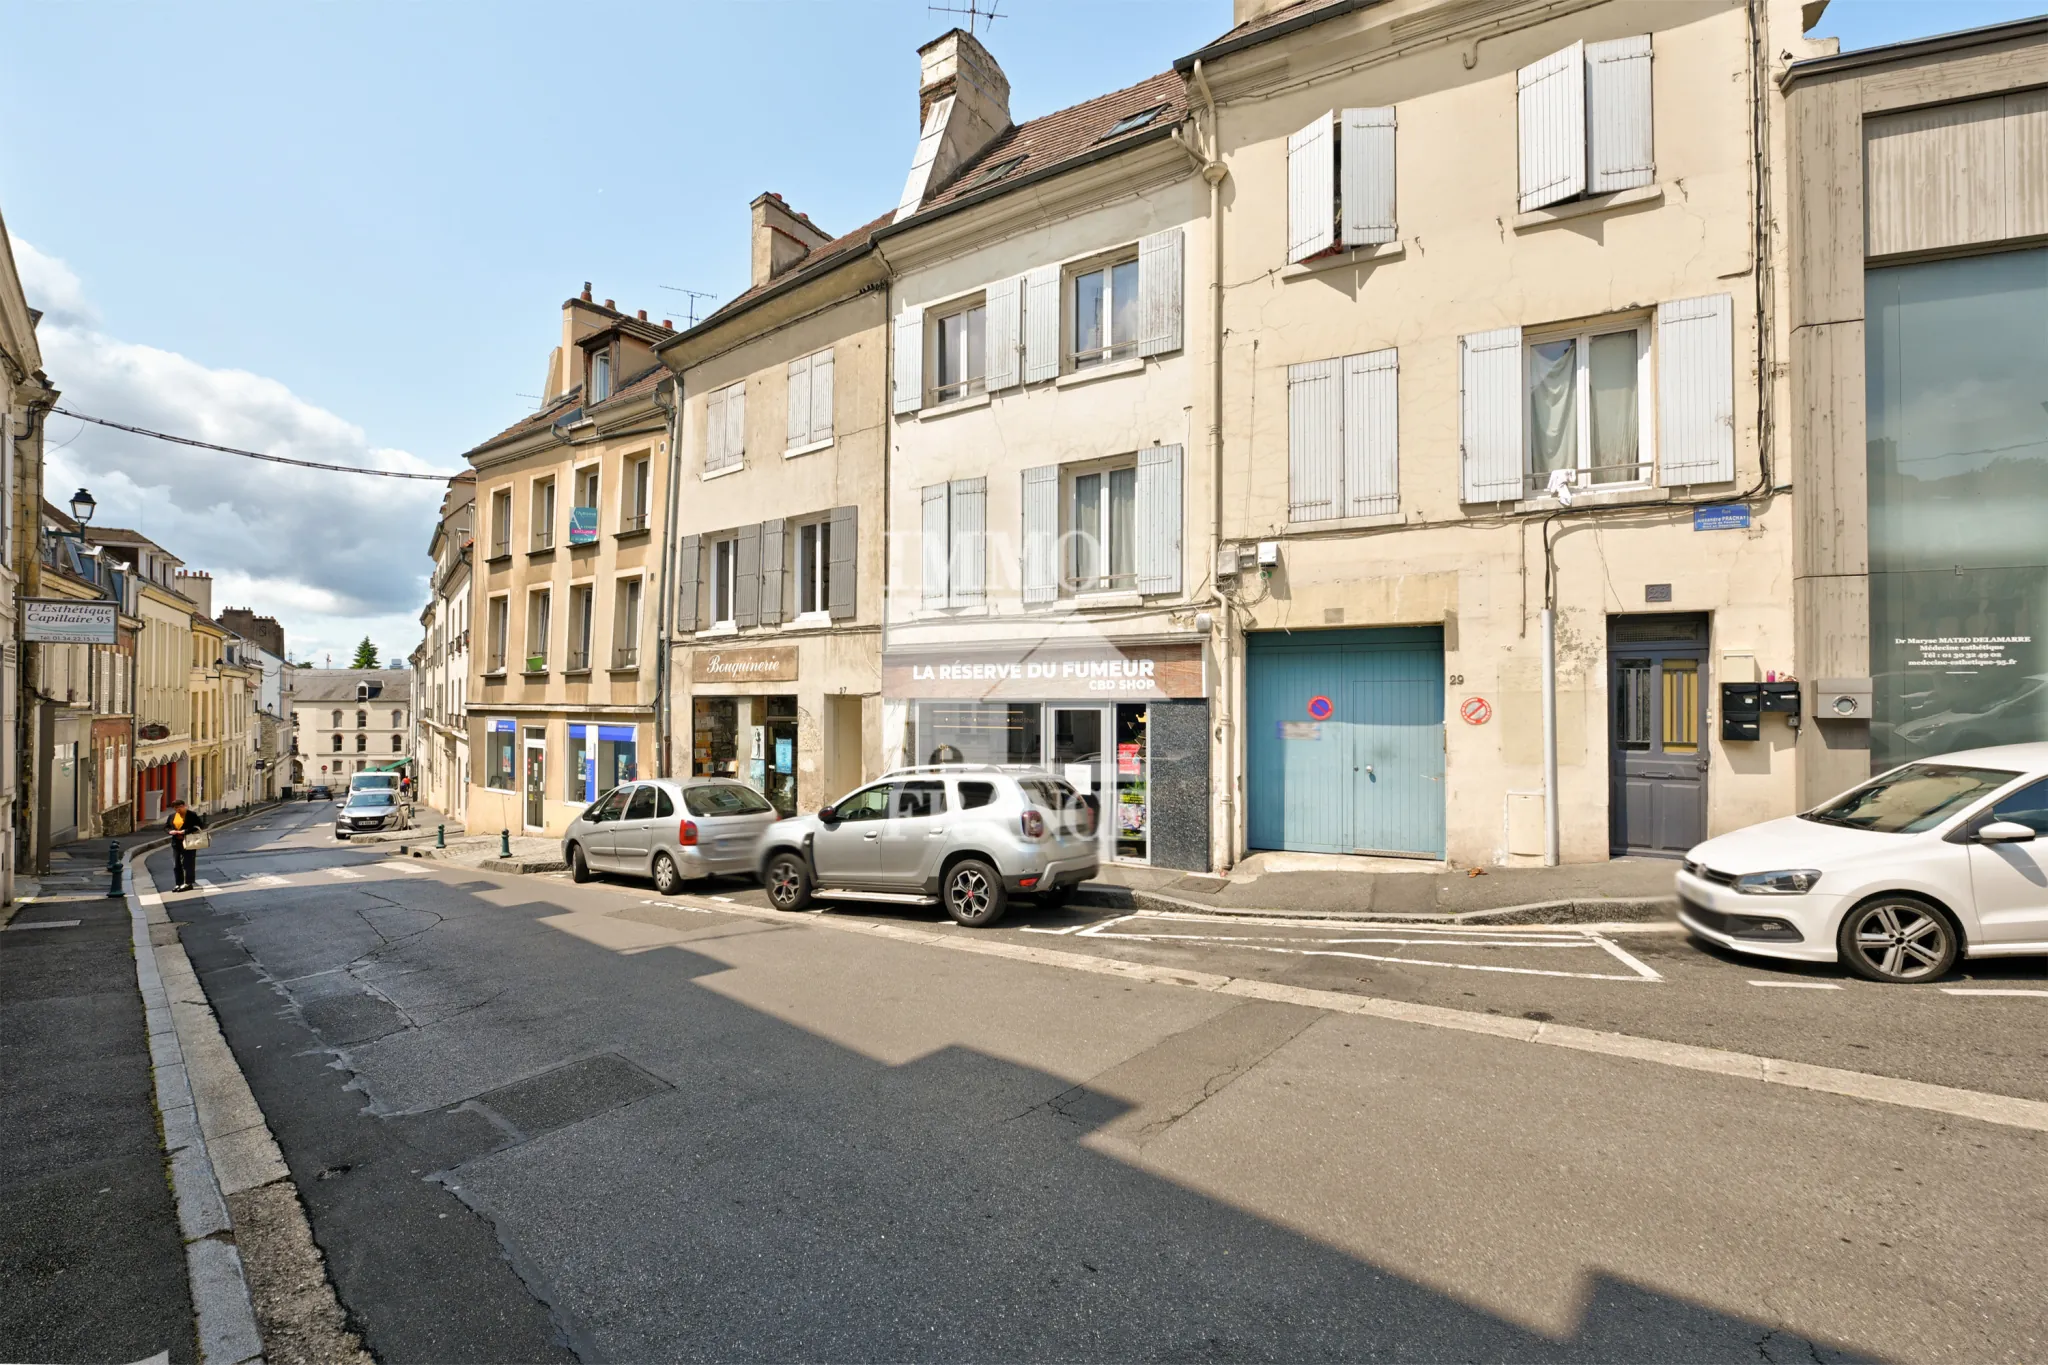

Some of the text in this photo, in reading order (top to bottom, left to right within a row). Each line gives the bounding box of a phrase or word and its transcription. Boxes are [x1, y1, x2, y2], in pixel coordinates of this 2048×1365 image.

[28, 603, 112, 616] L'Esthétique
[28, 613, 111, 624] Capillaire 95
[707, 654, 780, 677] Bouquinerie
[913, 659, 1155, 680] LA RÉSERVE DU FUMEUR
[1089, 679, 1156, 690] CBD SHOP
[1450, 675, 1464, 686] 29
